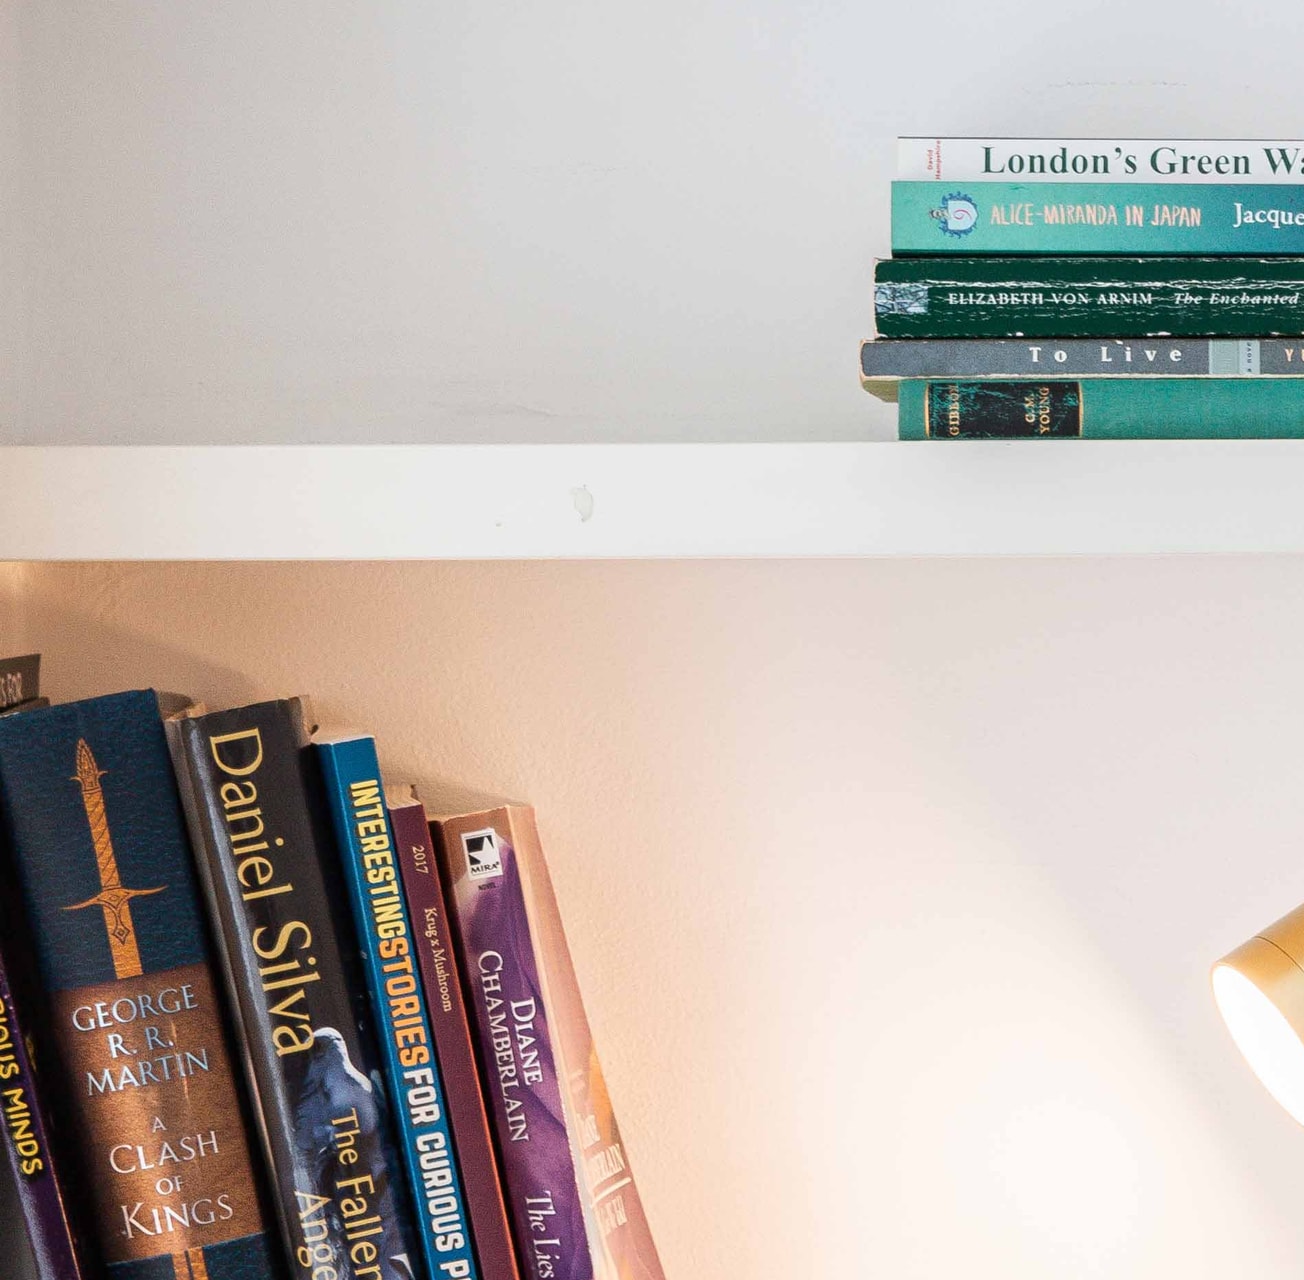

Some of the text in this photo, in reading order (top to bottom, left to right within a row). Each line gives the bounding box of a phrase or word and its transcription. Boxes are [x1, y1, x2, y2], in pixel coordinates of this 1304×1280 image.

[981, 146, 1138, 174] London’s
[1149, 147, 1252, 174] Green
[990, 203, 1202, 227] ALICE-MIRANDA IN JAPAN
[948, 292, 1044, 305] ELIZABETH
[1051, 293, 1089, 304] VON
[1097, 293, 1153, 305] ARNIM
[1174, 292, 1202, 305] The
[1209, 292, 1299, 306] Enchanted
[1029, 347, 1182, 362] To Live
[1037, 386, 1051, 435] YOUNG
[411, 845, 429, 874] 2017
[208, 726, 322, 1057] Daniel Silva
[423, 906, 438, 939] Krug
[430, 948, 453, 1012] Mushroom
[71, 984, 198, 1031] GEORGE
[108, 1026, 174, 1058] R. R.
[477, 950, 531, 1143] CHAMBERLAIN
[510, 996, 544, 1087] DIANE
[86, 1049, 210, 1096] MARTIN
[401, 1066, 436, 1127] FOR
[3, 1087, 43, 1176] MINDS
[151, 1117, 166, 1133] A
[331, 1107, 359, 1166] The
[109, 1130, 219, 1174] CLASH
[154, 1175, 184, 1195] OF
[415, 1131, 466, 1253] CURIOUS
[121, 1193, 234, 1239] KINGS
[525, 1190, 557, 1233] The
[533, 1238, 560, 1280] Lies
